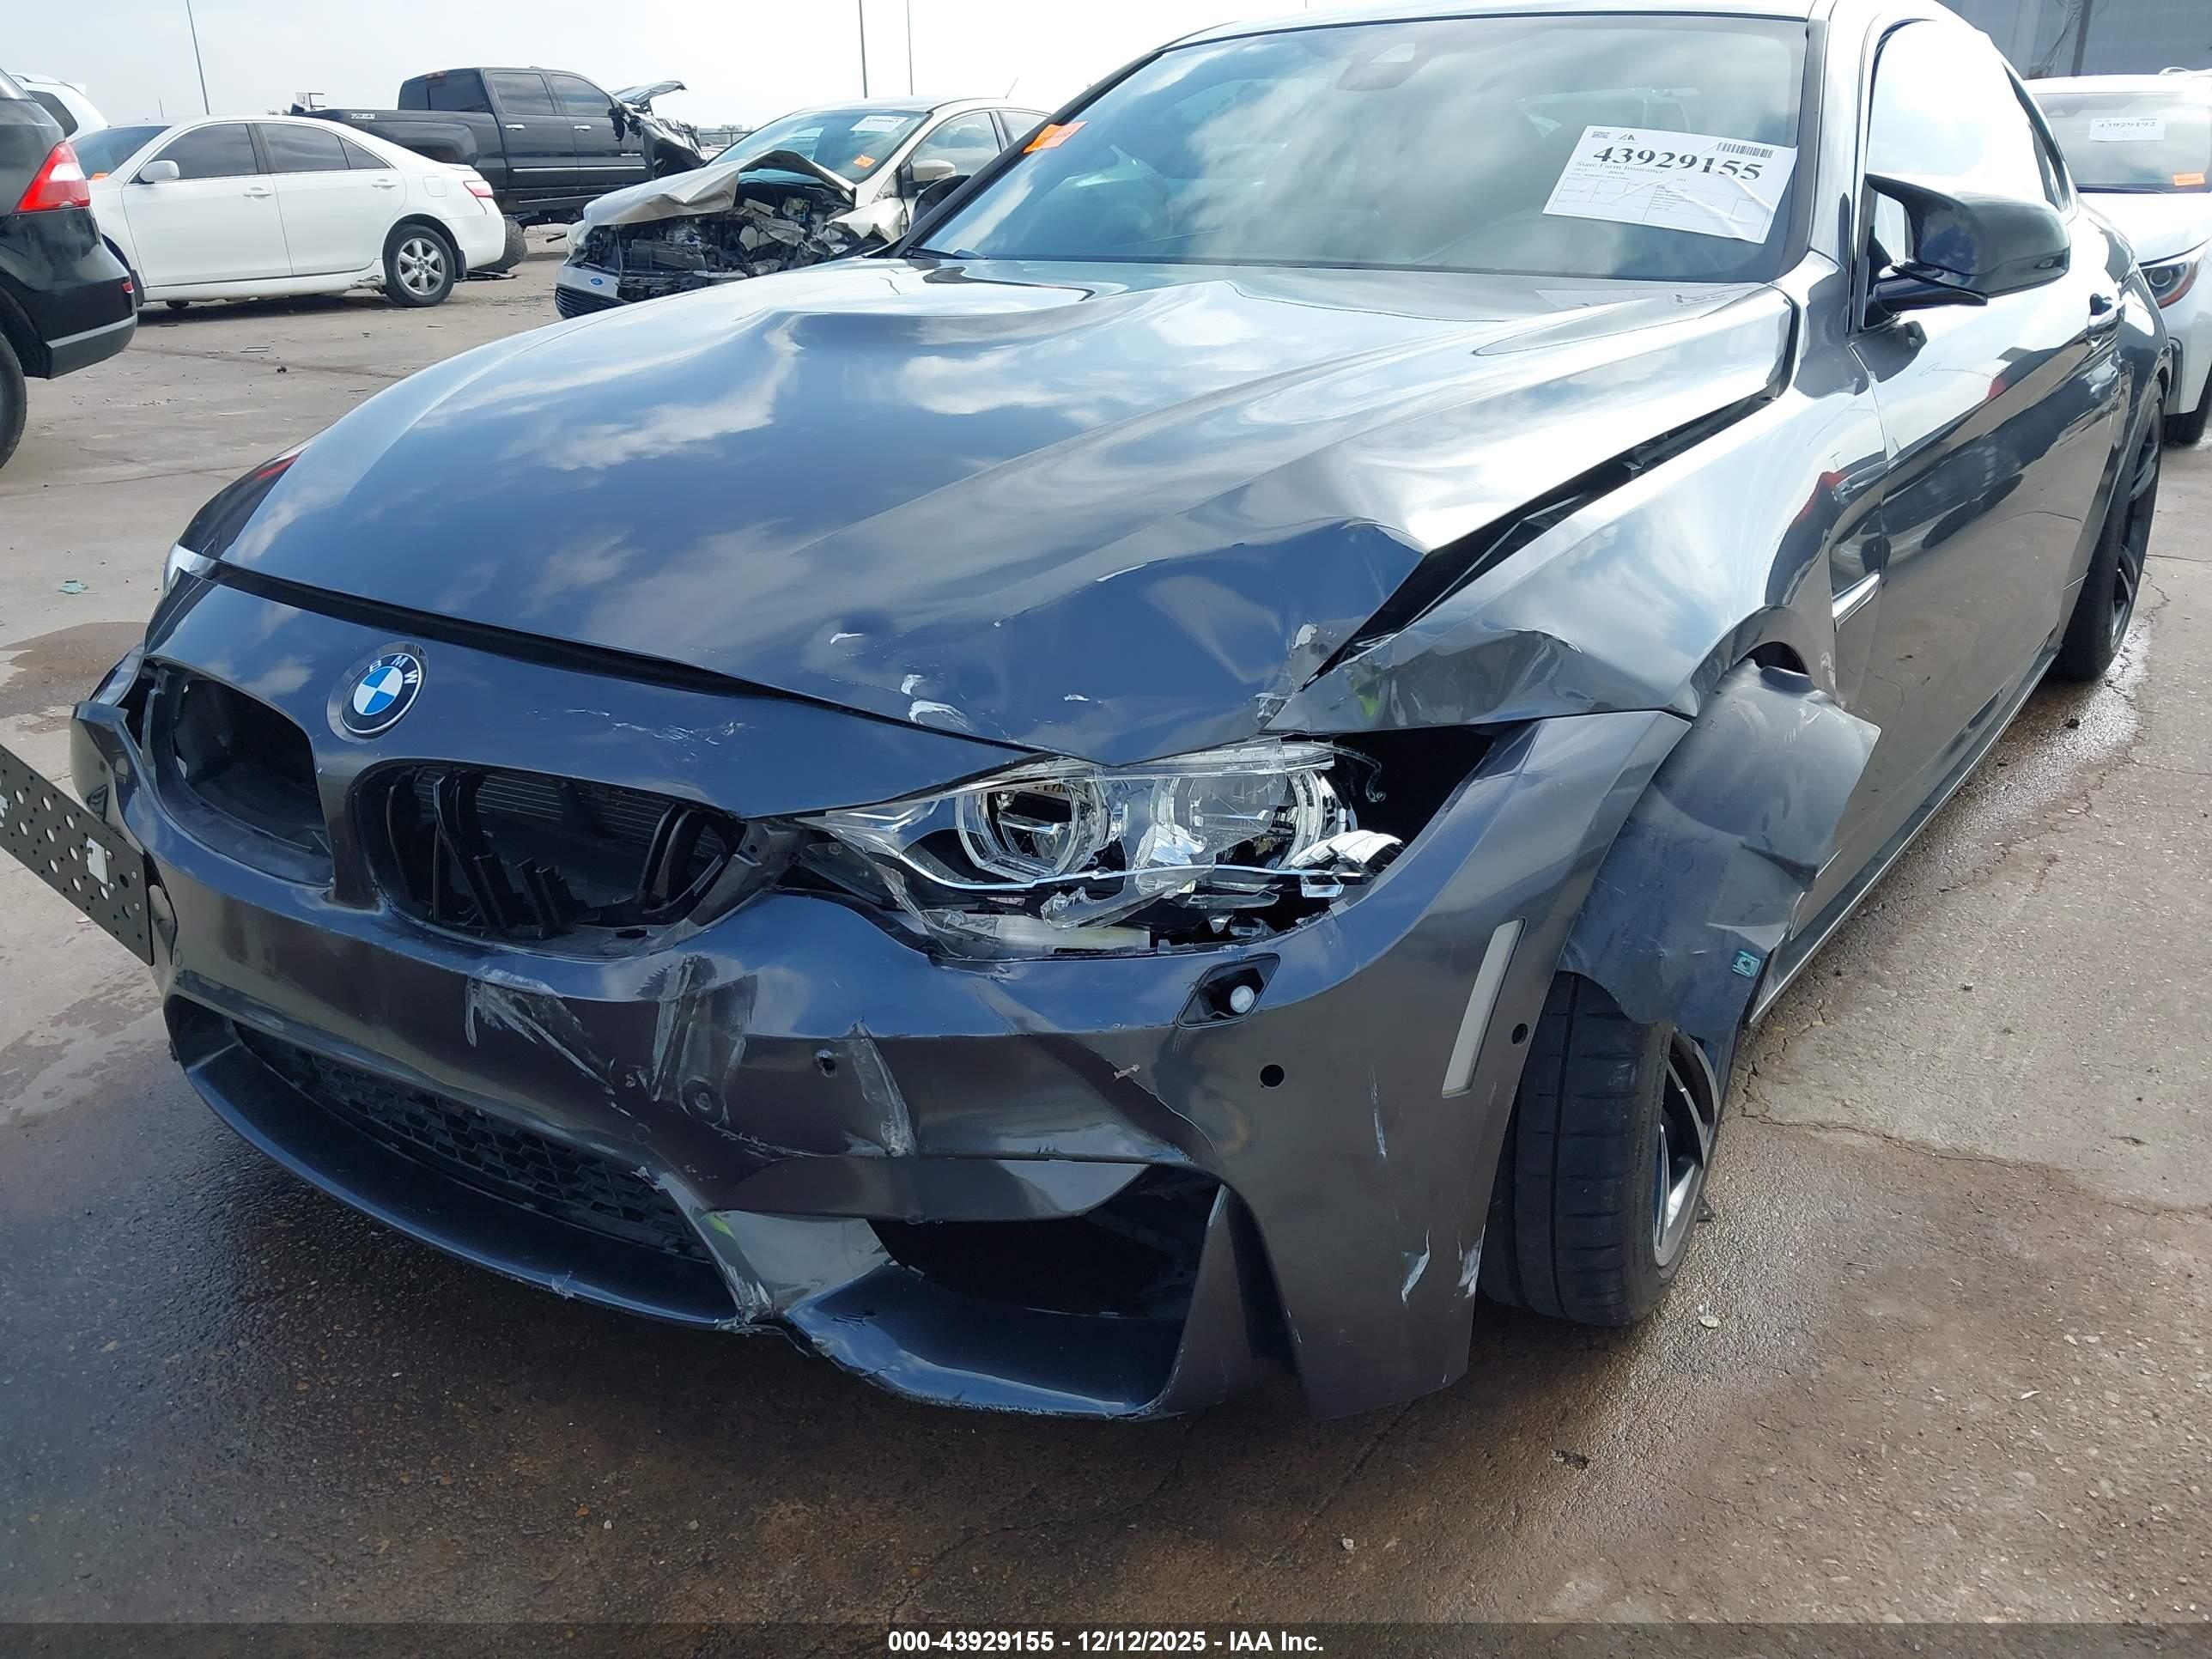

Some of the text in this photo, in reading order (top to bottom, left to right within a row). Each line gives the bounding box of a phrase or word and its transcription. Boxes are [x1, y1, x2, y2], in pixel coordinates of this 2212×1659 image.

[1593, 146, 1764, 180] 43929155
[1623, 164, 1666, 174] Insurance
[369, 655, 418, 684] BMW
